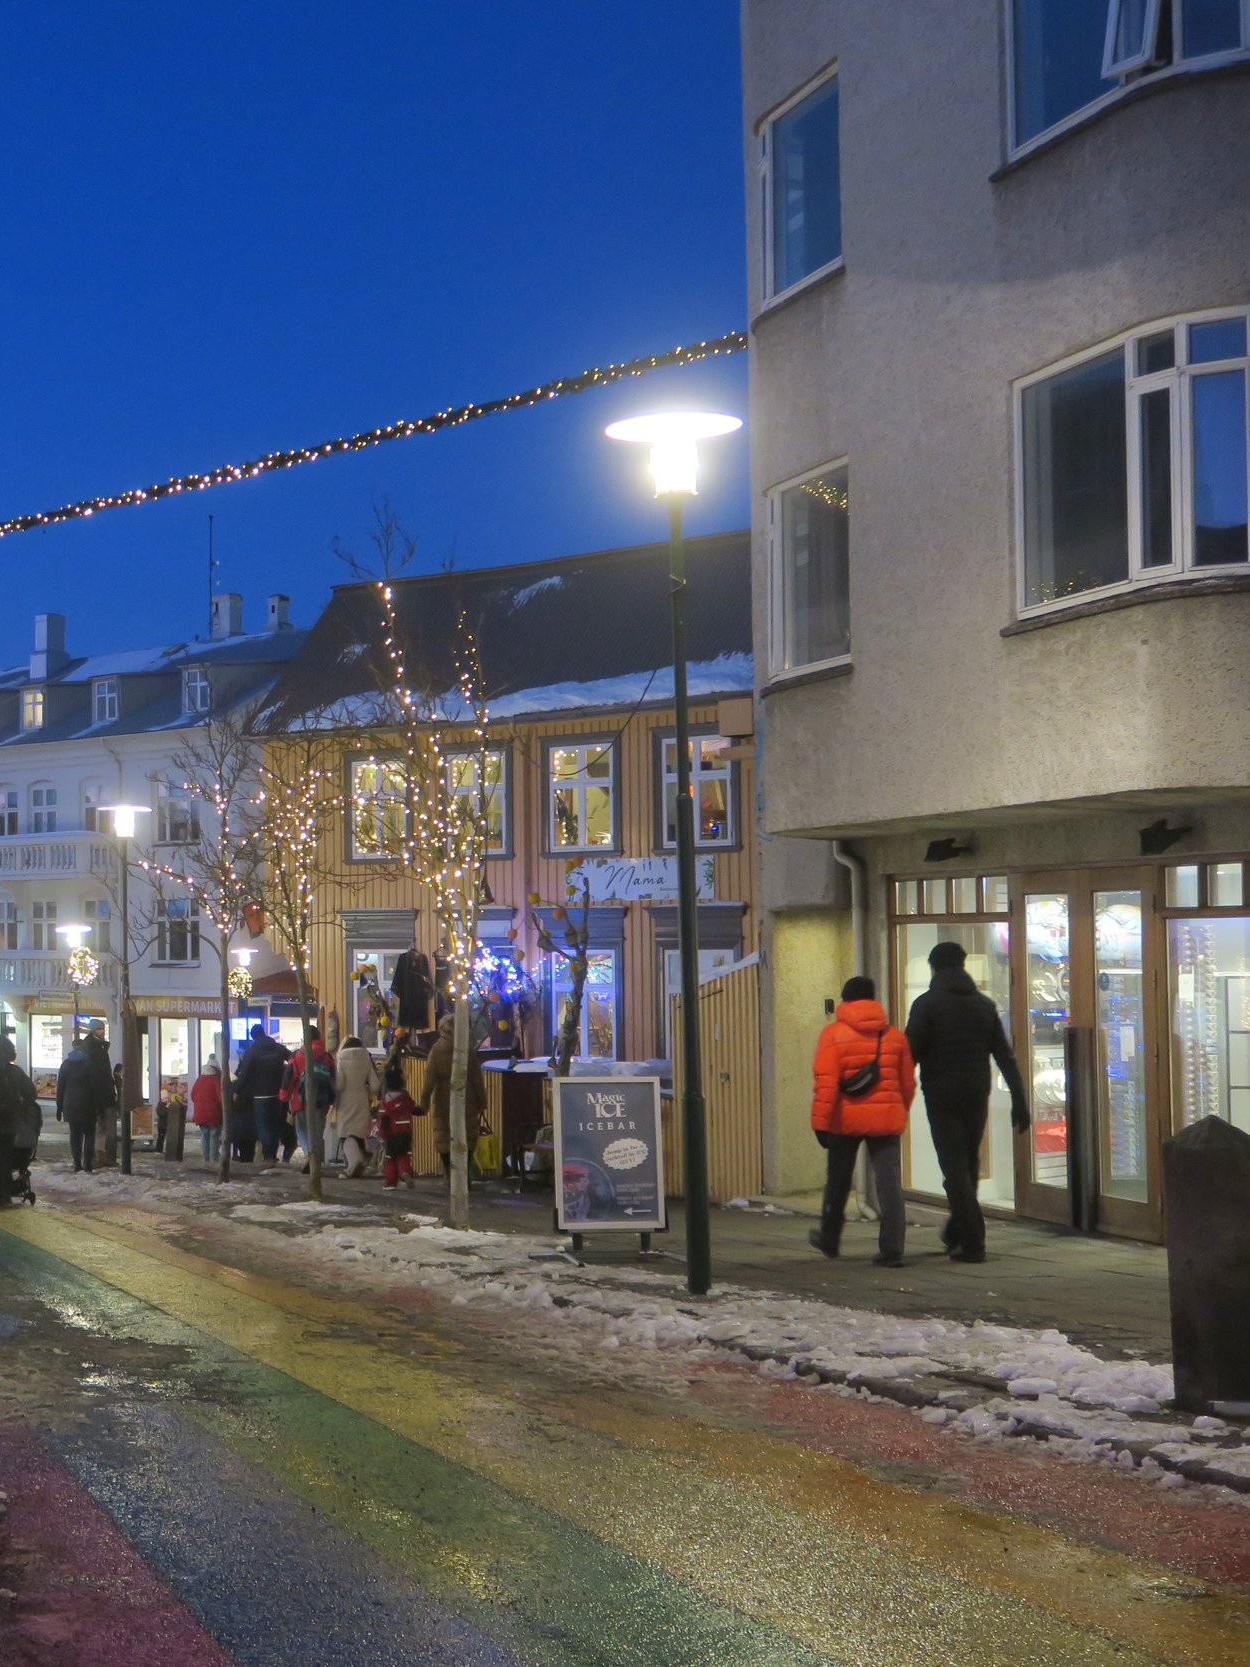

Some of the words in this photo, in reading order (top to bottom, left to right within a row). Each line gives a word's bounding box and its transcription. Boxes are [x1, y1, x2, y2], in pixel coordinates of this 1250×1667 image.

[604, 865, 667, 895] Mama
[155, 1000, 236, 1014] SUPERMARKT
[586, 1092, 626, 1106] Magic
[595, 1103, 627, 1118] ICE
[578, 1121, 638, 1131] ICEBAR
